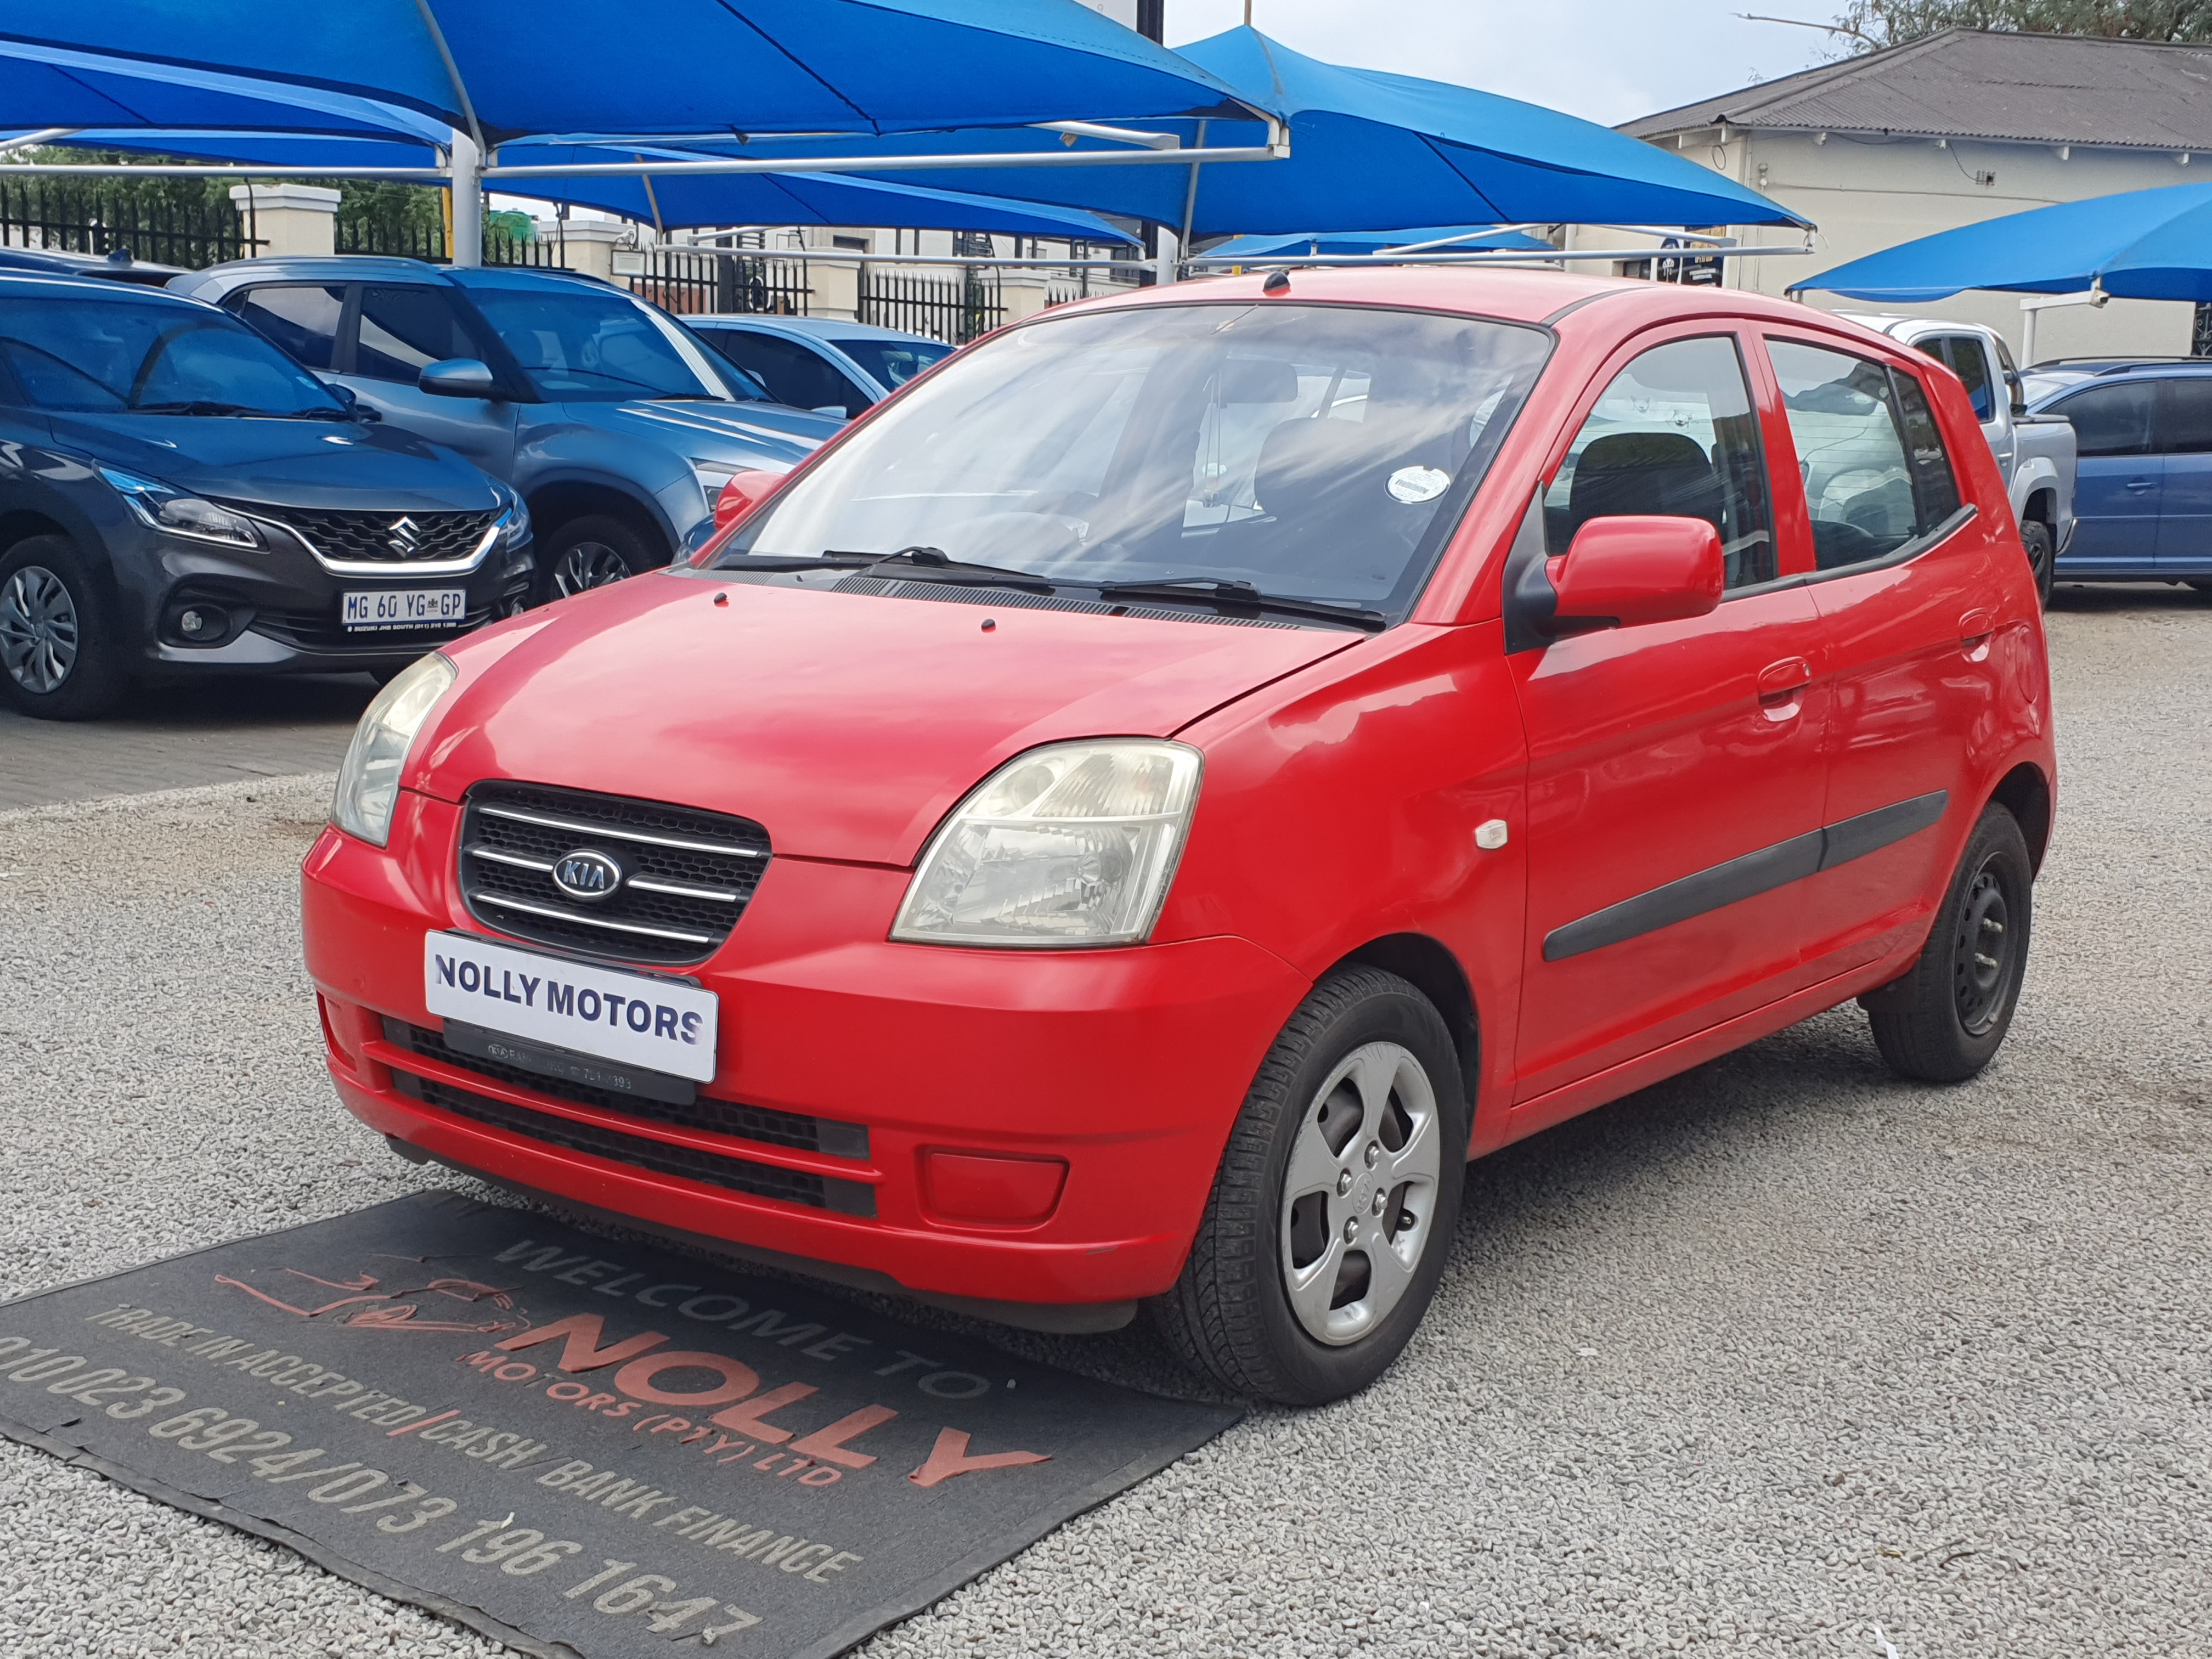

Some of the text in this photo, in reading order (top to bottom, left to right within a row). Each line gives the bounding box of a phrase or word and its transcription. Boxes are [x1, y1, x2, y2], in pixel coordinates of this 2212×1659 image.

[348, 593, 461, 619] MG 60 YG GP
[563, 860, 605, 889] KIA
[435, 954, 703, 1045] NOLLY MOTORS
[494, 1239, 991, 1399] WELCOME TO
[84, 1306, 215, 1346] TRADE
[185, 1335, 255, 1361] IN
[651, 1505, 865, 1583] FINANCE
[494, 1312, 1052, 1487] NOLLY
[47, 1368, 187, 1419] 023
[435, 1517, 583, 1576] 196
[563, 1558, 763, 1645] 1647
[752, 1452, 842, 1486] LTD
